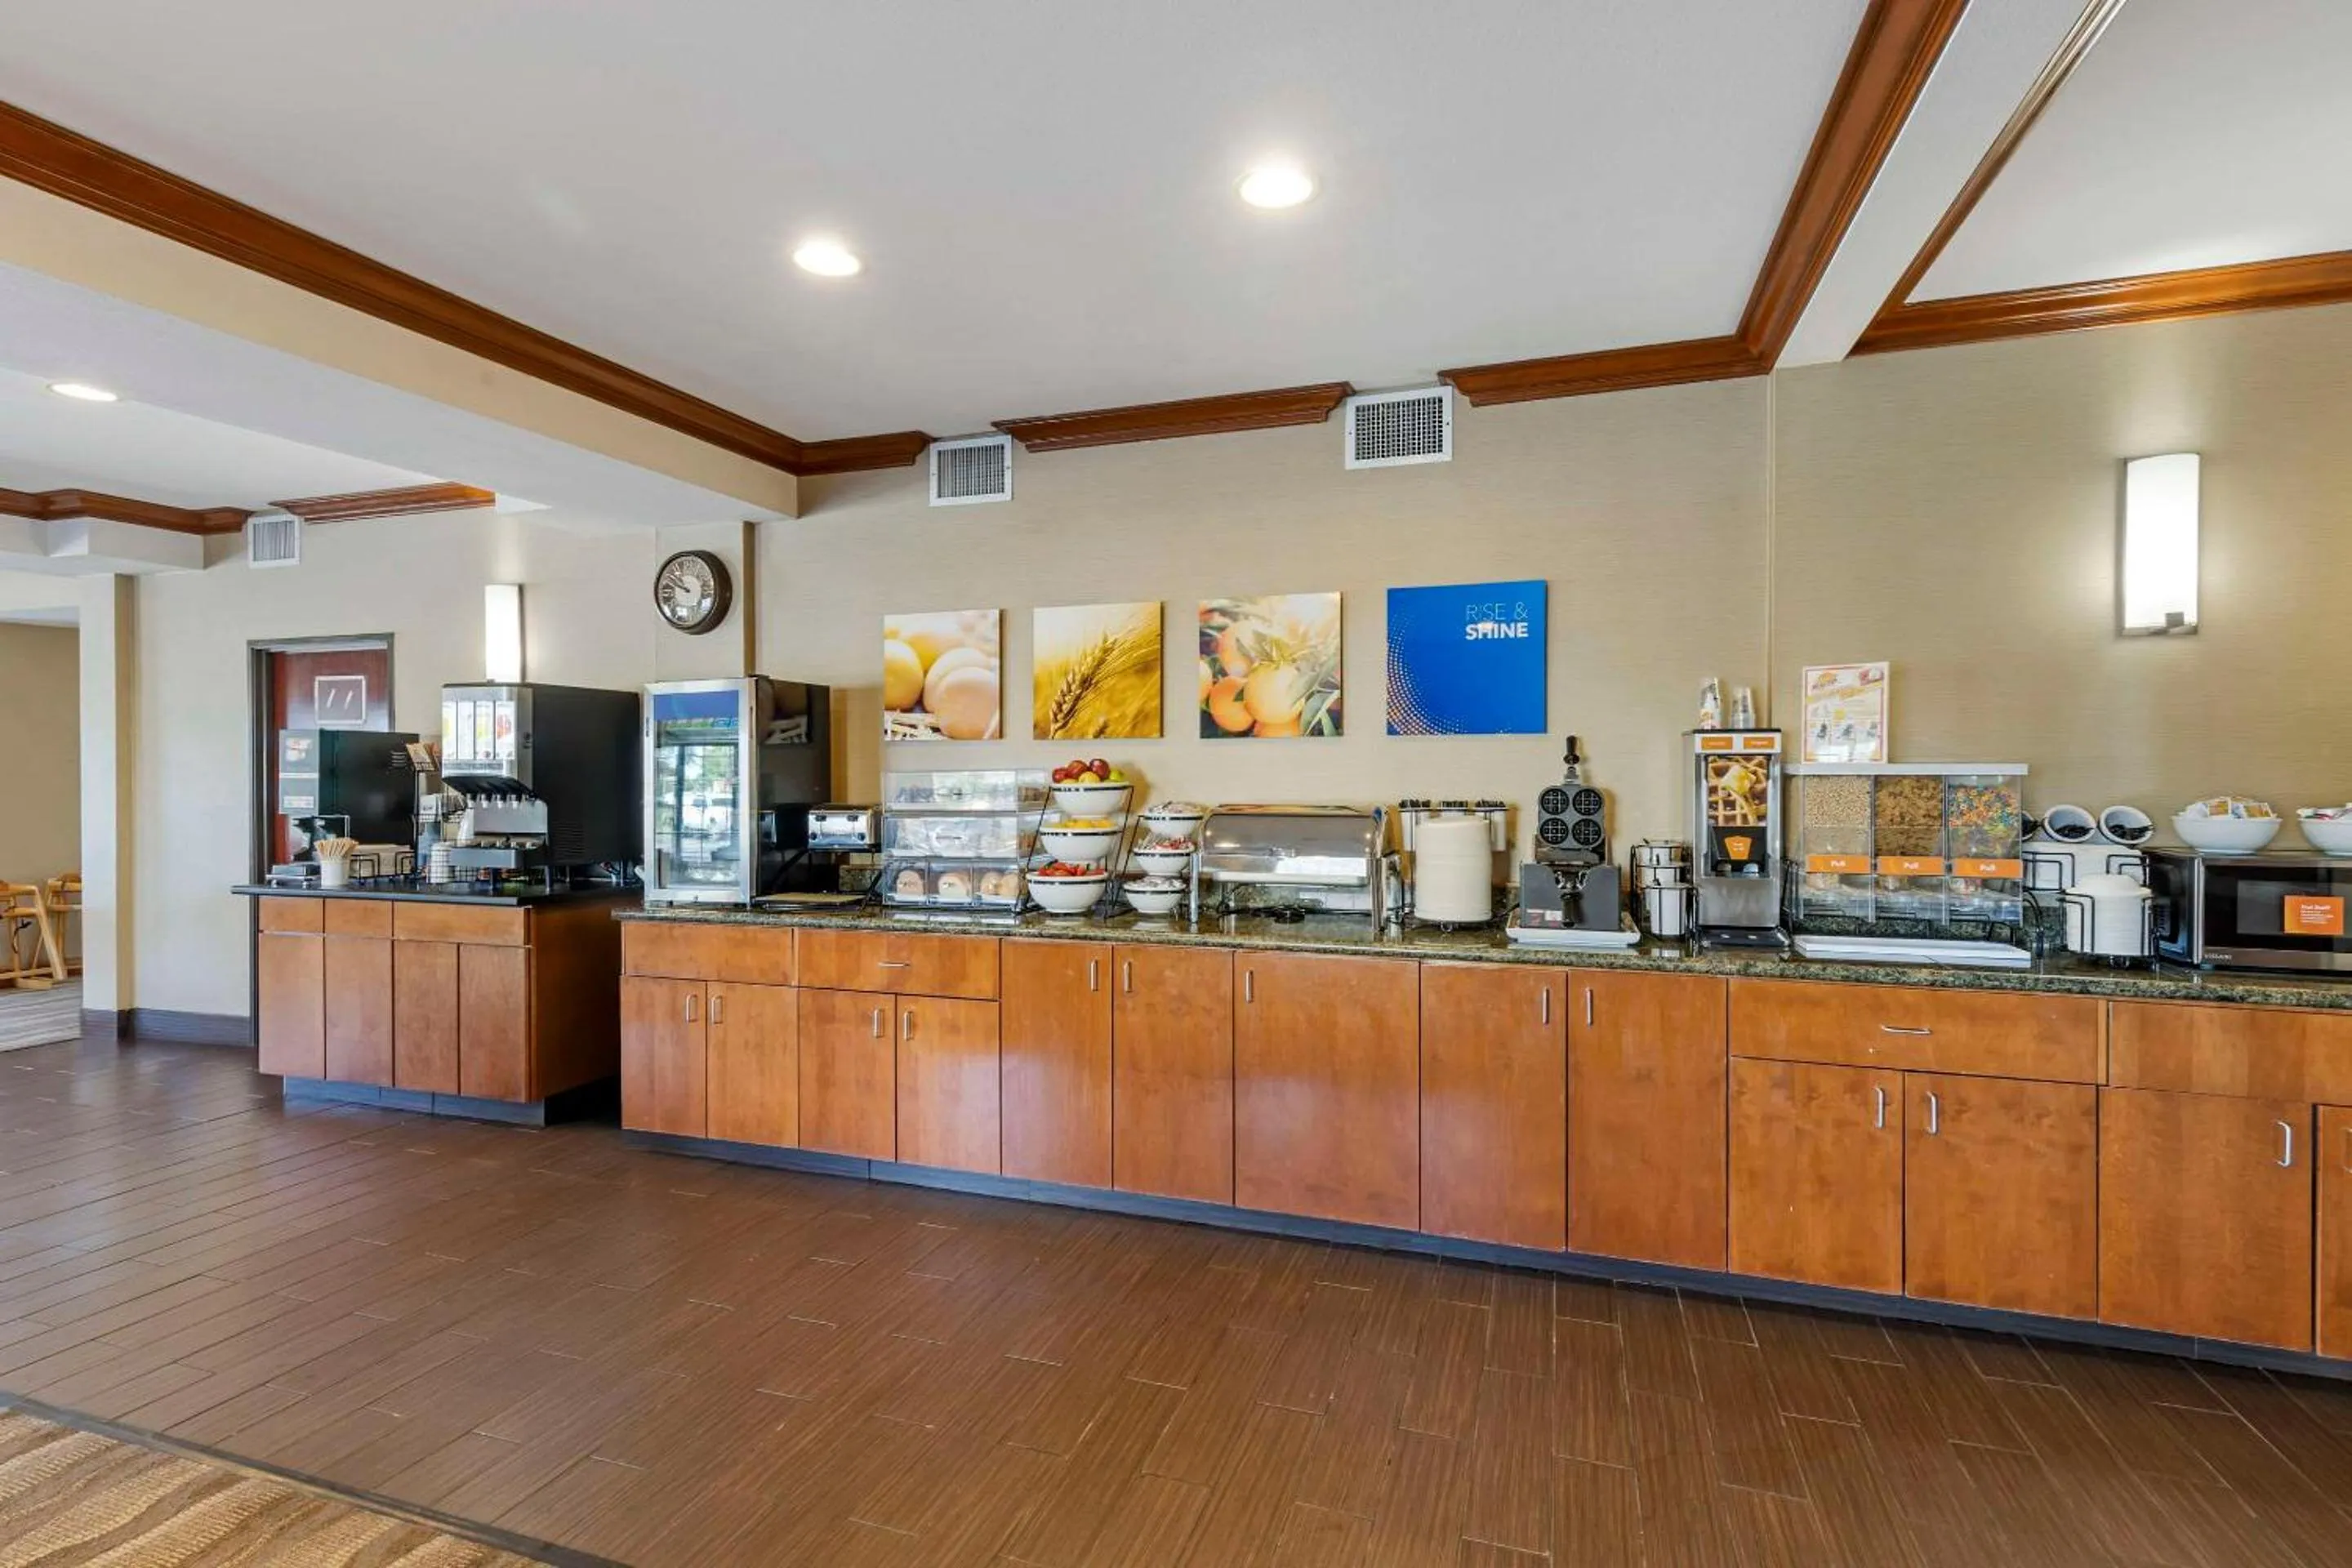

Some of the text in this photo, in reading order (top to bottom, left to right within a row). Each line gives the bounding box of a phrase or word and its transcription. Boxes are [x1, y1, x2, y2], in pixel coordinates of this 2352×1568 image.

[1466, 601, 1528, 621] RISE &
[1465, 621, 1529, 640] SHINE
